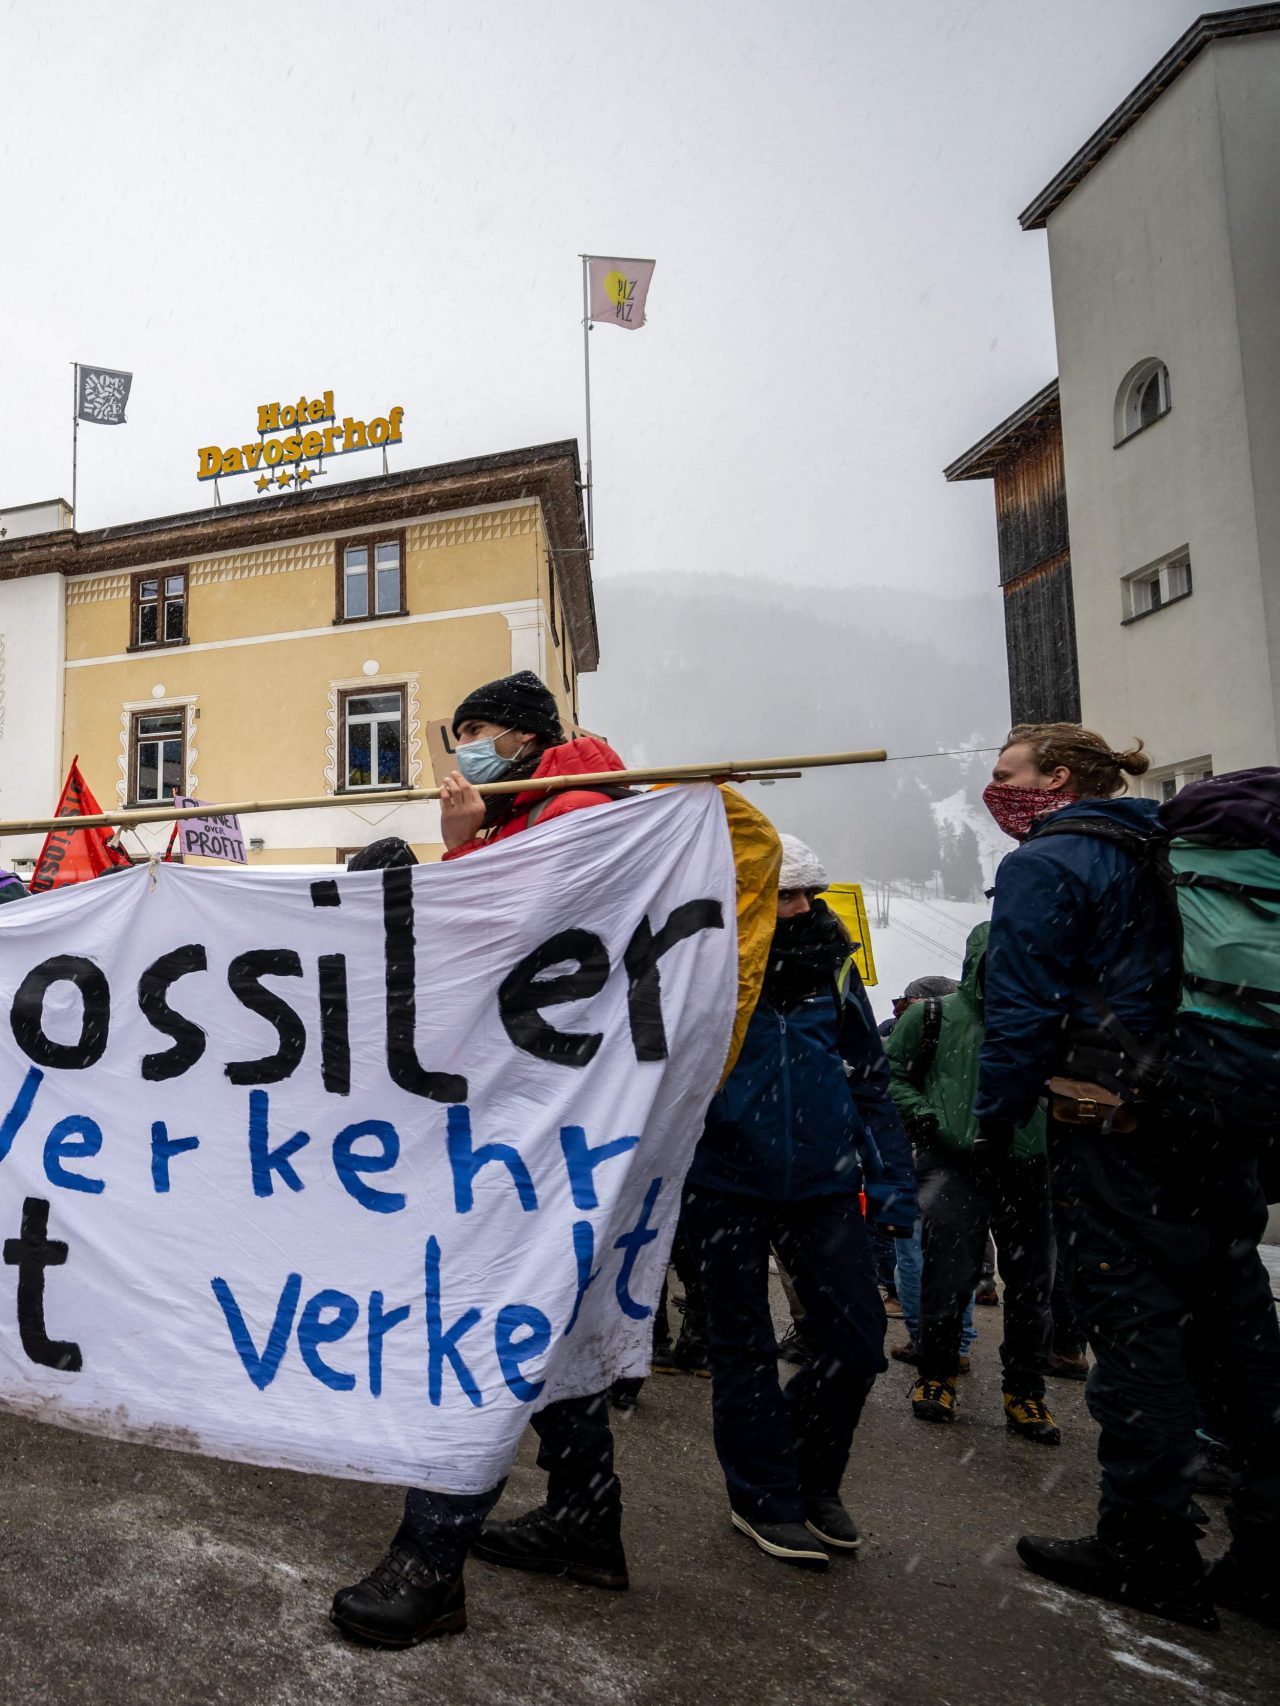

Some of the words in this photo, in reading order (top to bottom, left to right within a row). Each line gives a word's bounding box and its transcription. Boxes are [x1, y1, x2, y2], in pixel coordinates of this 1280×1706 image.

[257, 391, 335, 433] Hotel
[196, 406, 404, 481] Davoserhof
[185, 829, 244, 862] PROFIT
[204, 824, 226, 836] OVER
